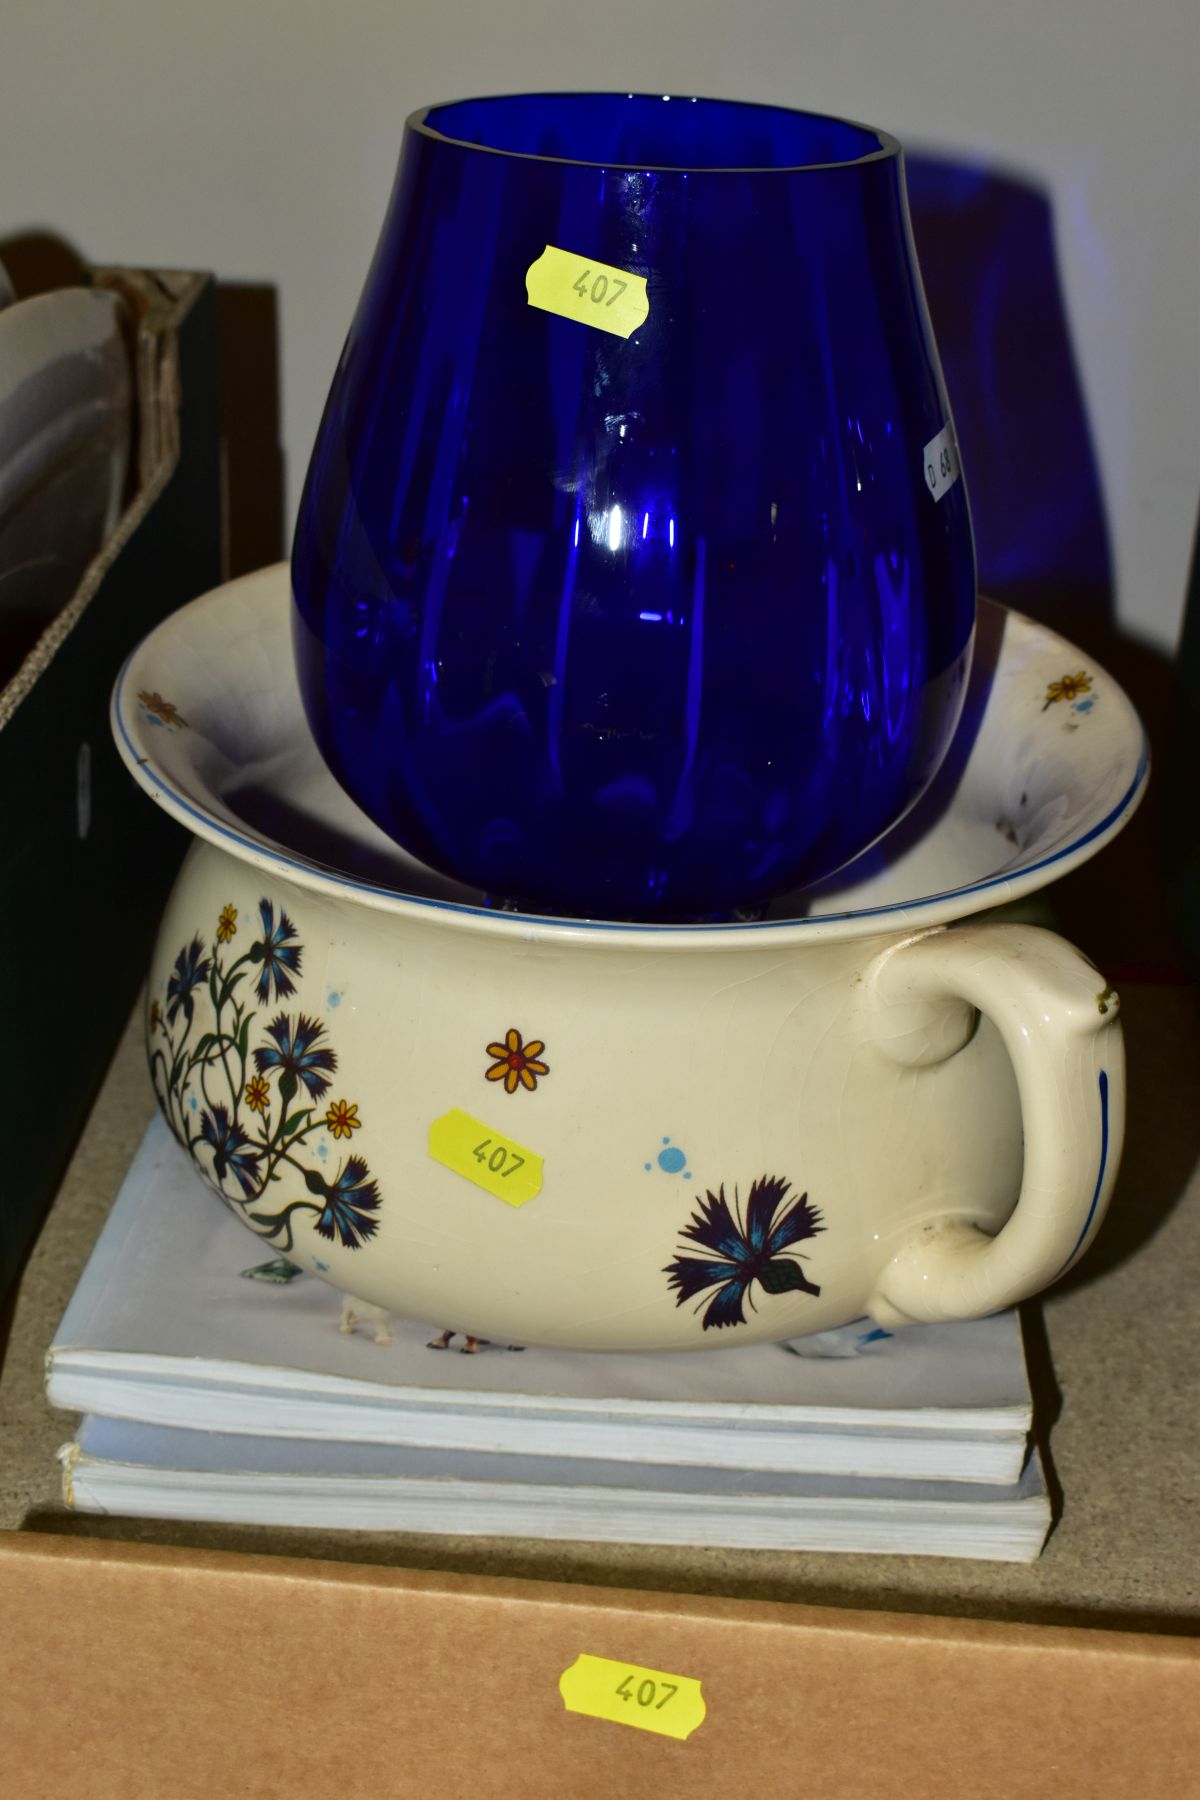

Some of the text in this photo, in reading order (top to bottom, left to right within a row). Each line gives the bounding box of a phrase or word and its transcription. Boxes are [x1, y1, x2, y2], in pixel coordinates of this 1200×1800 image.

[572, 269, 628, 307] 407
[472, 1139, 526, 1178] 407
[615, 1675, 679, 1710] 407
